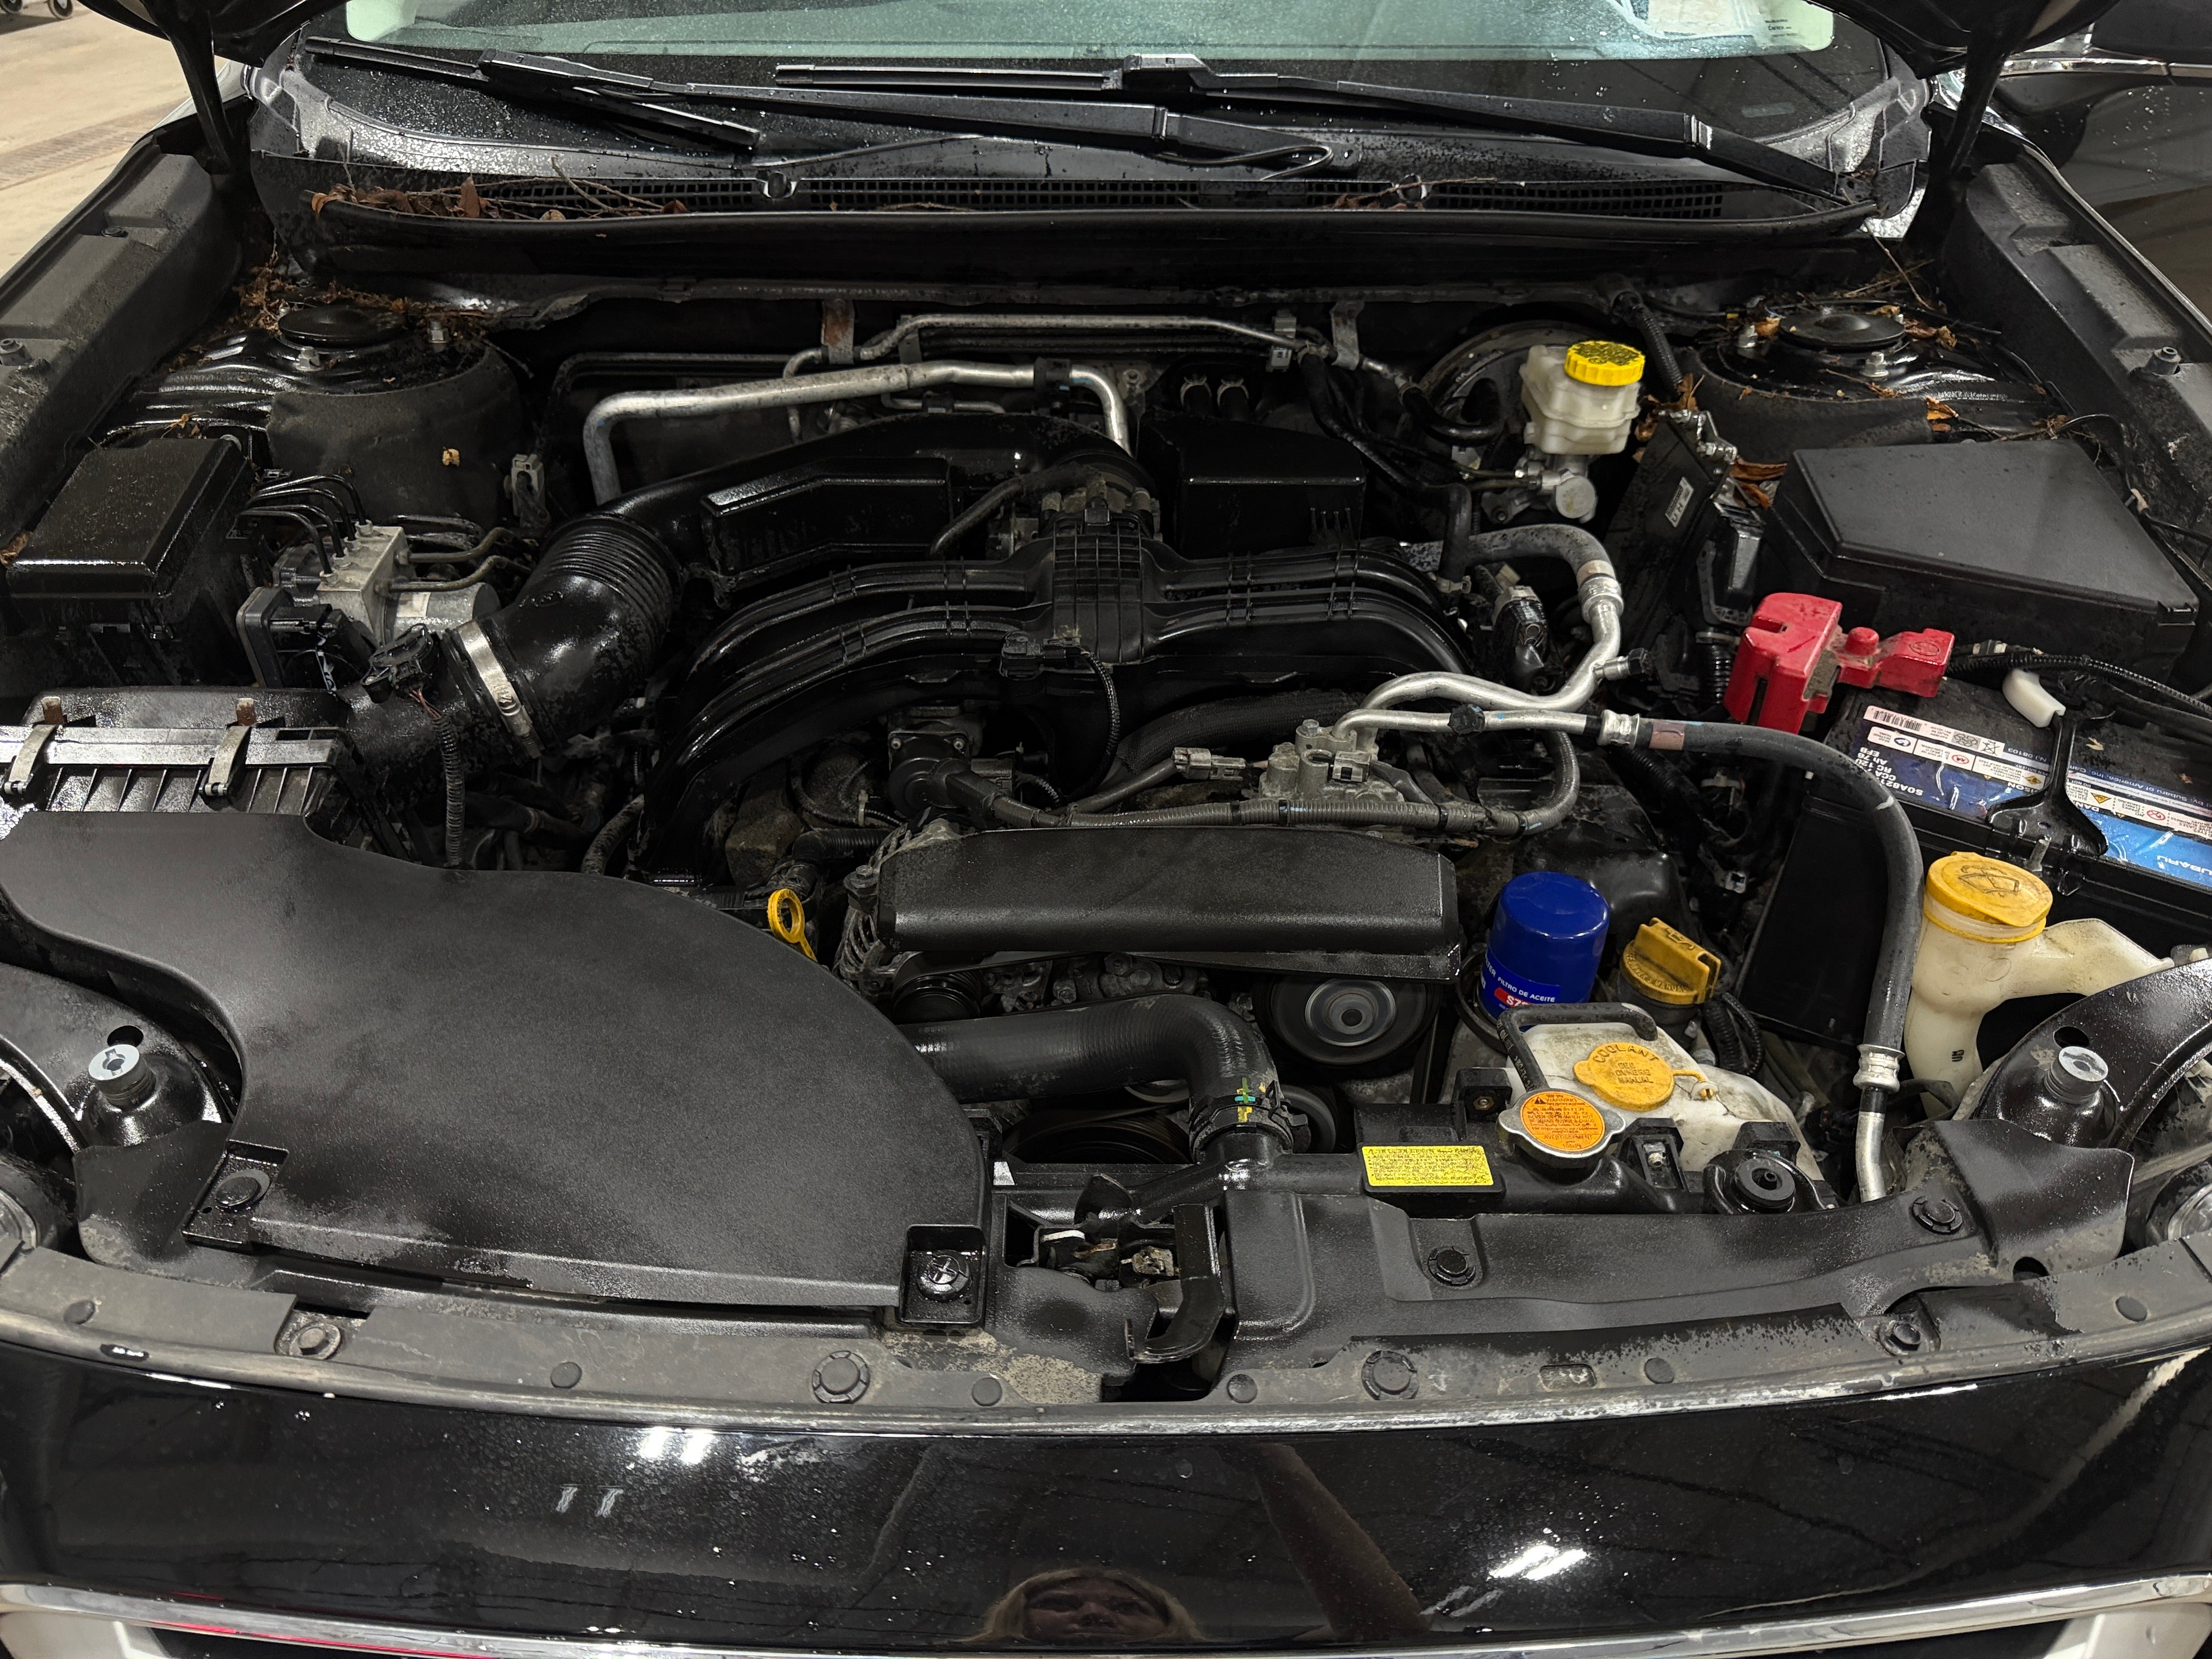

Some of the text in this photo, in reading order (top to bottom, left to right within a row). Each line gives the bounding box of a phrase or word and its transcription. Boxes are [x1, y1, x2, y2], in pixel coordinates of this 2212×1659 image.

[1860, 747, 1880, 758] EFB
[1873, 757, 1887, 765] Ah
[1877, 765, 1892, 774] RC
[1875, 770, 1897, 781] CCA
[2007, 782, 2038, 794] ISON
[2156, 788, 2187, 802] Subaru
[2157, 855, 2212, 876] UBARU
[1498, 976, 1517, 992] FILTRO
[1518, 989, 1528, 998] DE
[1530, 994, 1556, 1003] ACEITE
[1593, 1044, 1659, 1063] COOLANT
[1617, 1076, 1654, 1085] MANUAL
